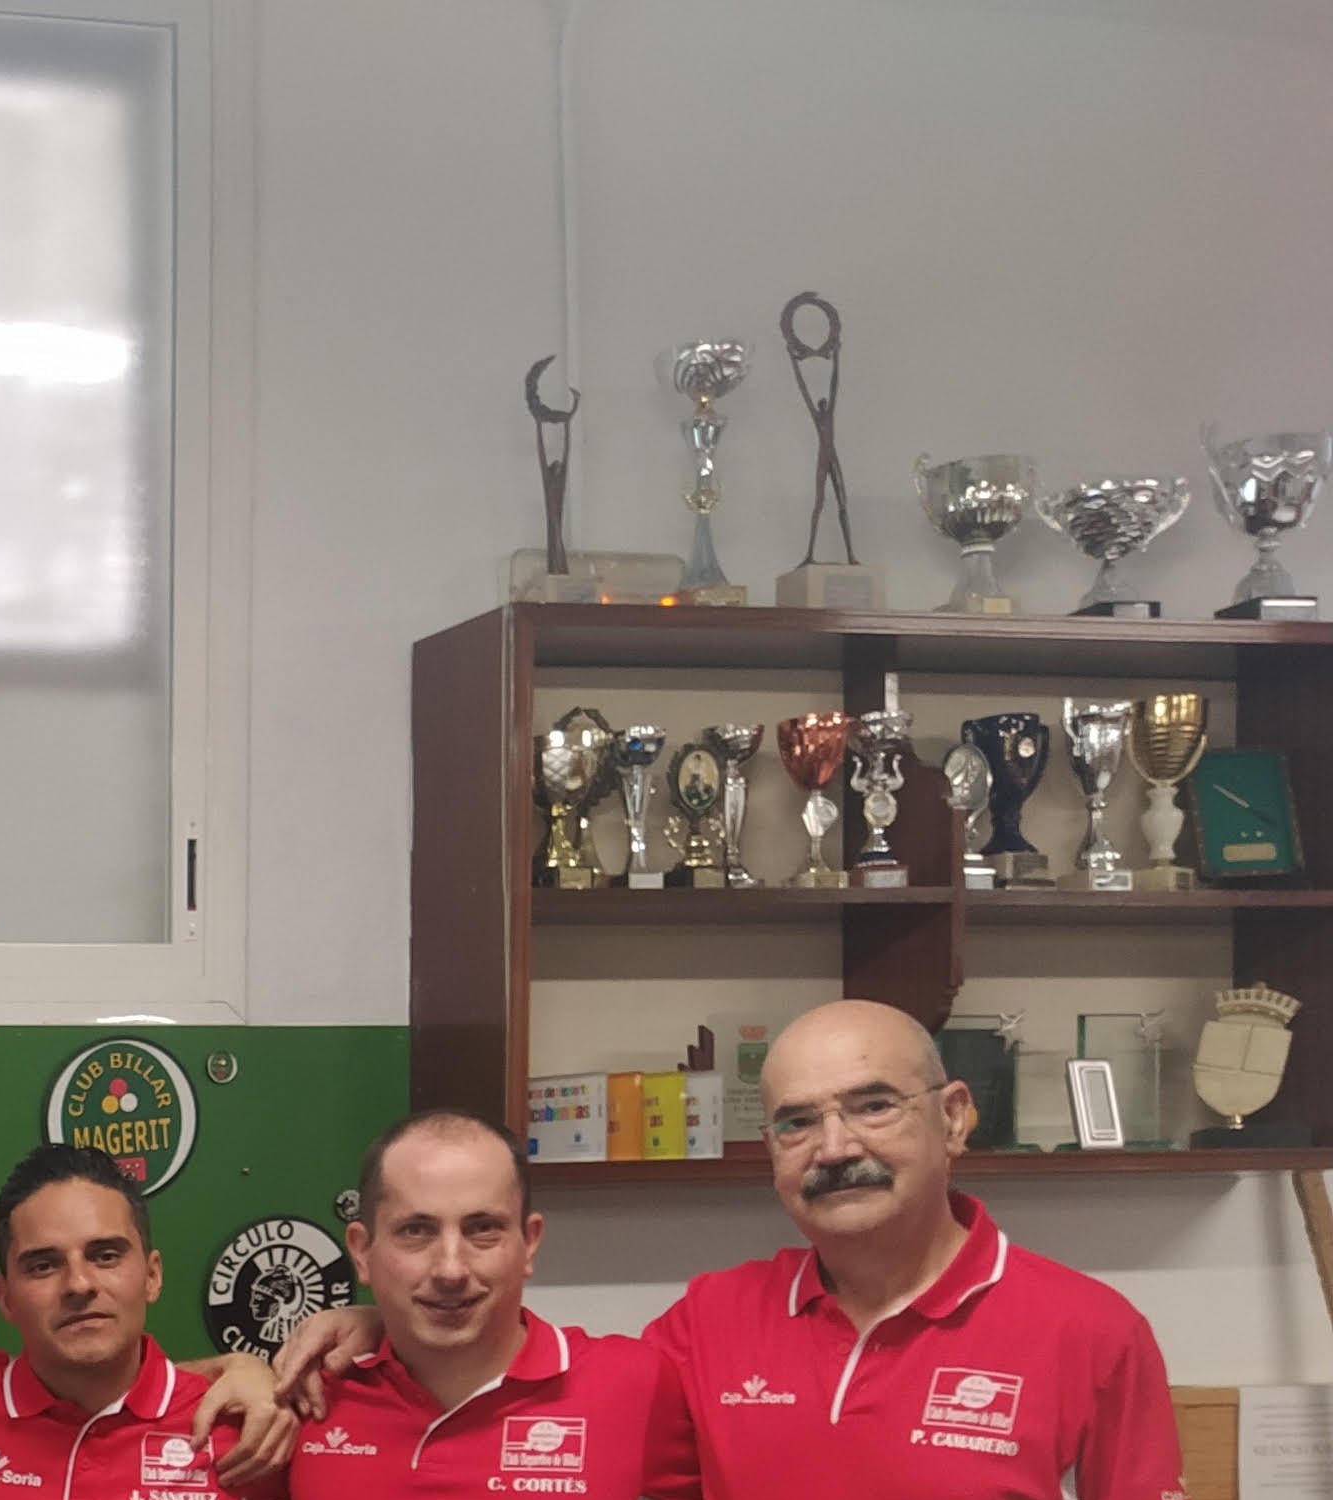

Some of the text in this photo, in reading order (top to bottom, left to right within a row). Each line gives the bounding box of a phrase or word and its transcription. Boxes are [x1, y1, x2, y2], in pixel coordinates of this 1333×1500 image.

[68, 1052, 172, 1116] CLUB BILLAR
[73, 1117, 172, 1155] MAGERIT
[212, 1221, 294, 1296] CIRCULO
[910, 1429, 928, 1445] P.
[487, 1476, 588, 1495] C. CORTÉS
